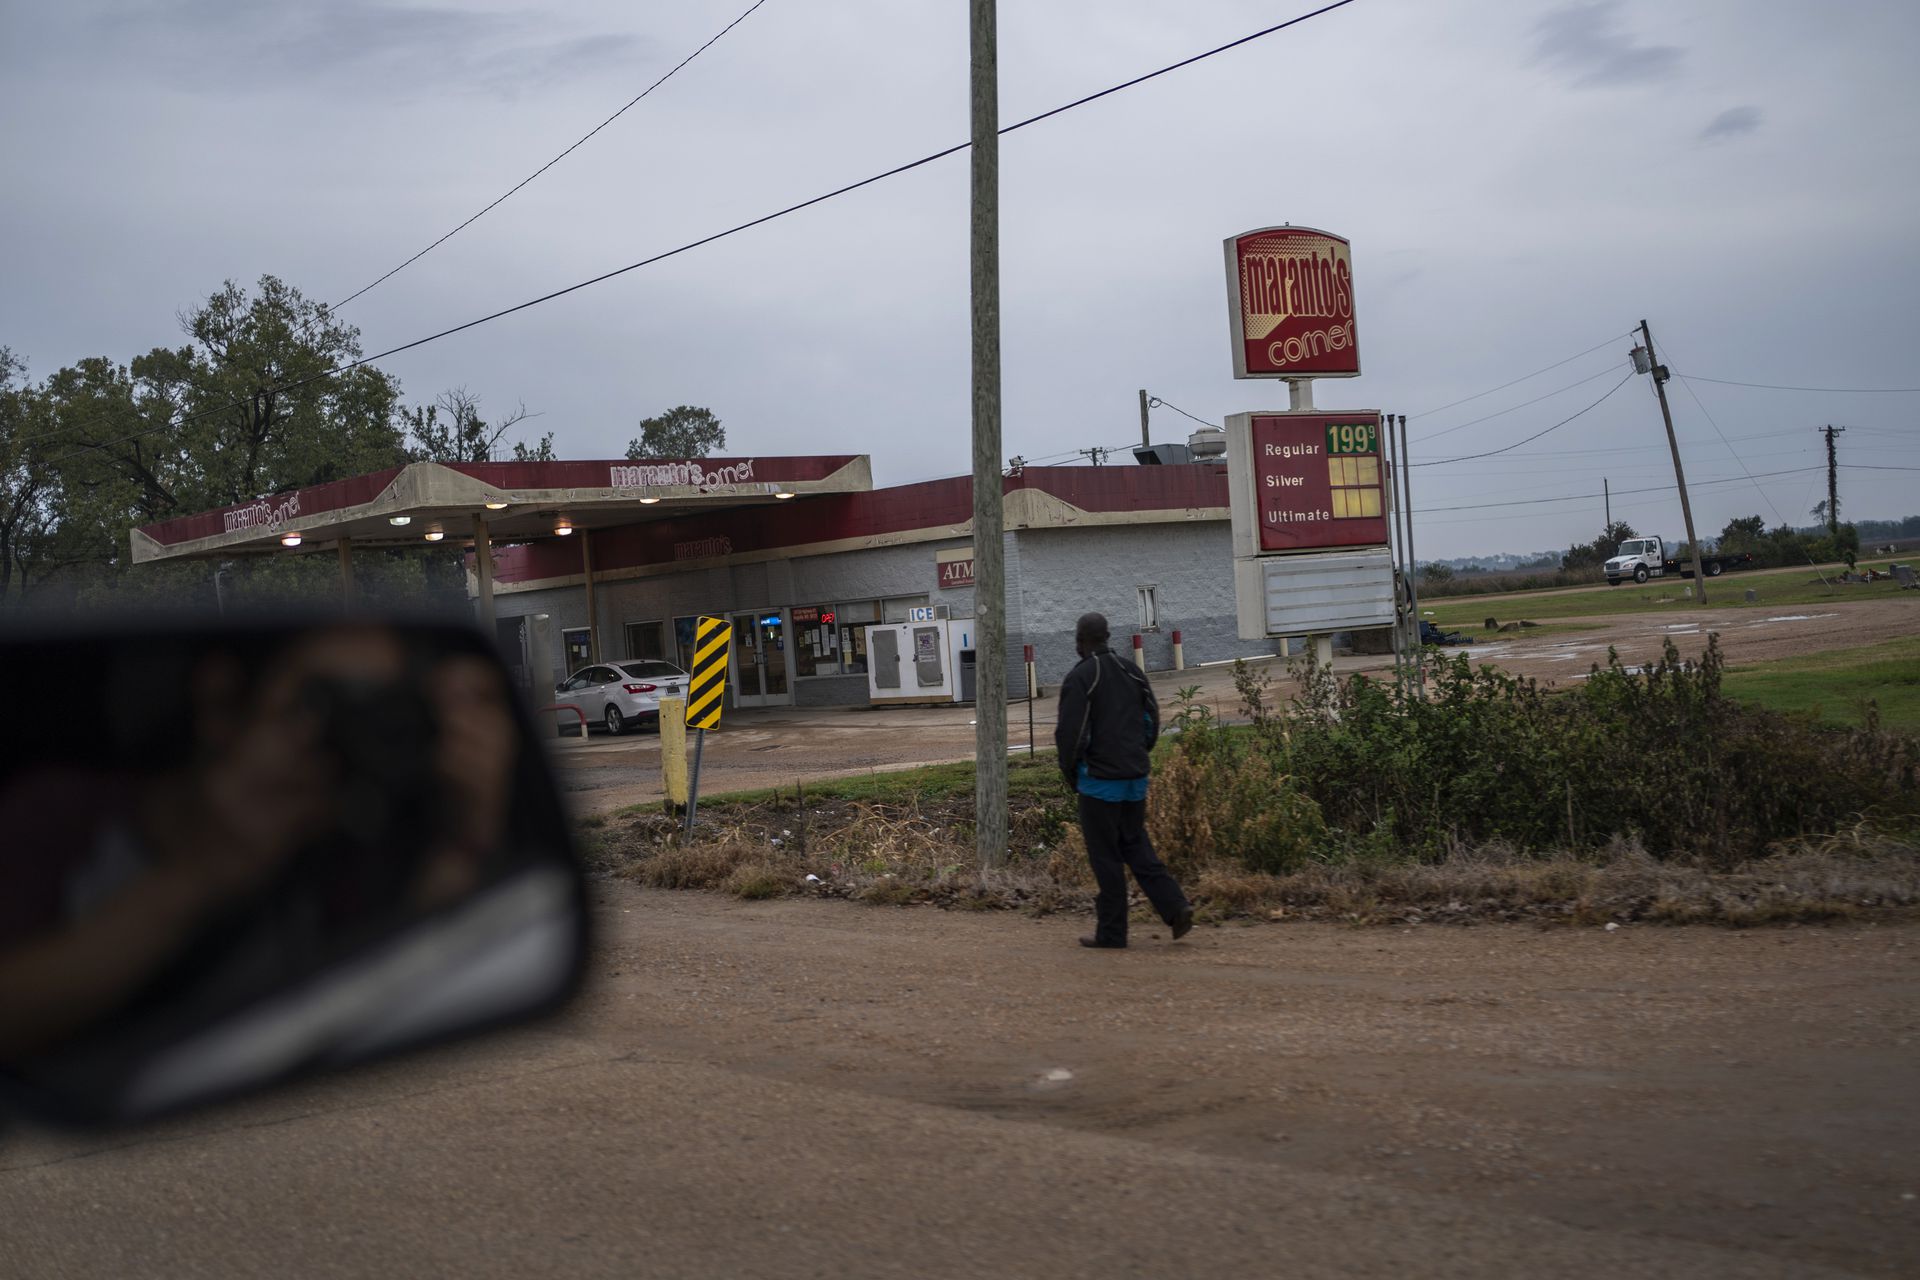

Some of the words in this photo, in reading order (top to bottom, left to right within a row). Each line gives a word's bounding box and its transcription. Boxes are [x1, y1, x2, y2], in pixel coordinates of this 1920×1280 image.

[1245, 246, 1352, 317] maranto's
[1268, 319, 1353, 367] corner
[1265, 443, 1319, 458] Regular
[1266, 475, 1304, 487] Silver
[1268, 509, 1329, 523] Ultimate
[943, 561, 975, 580] ATM
[911, 607, 933, 621] ICE
